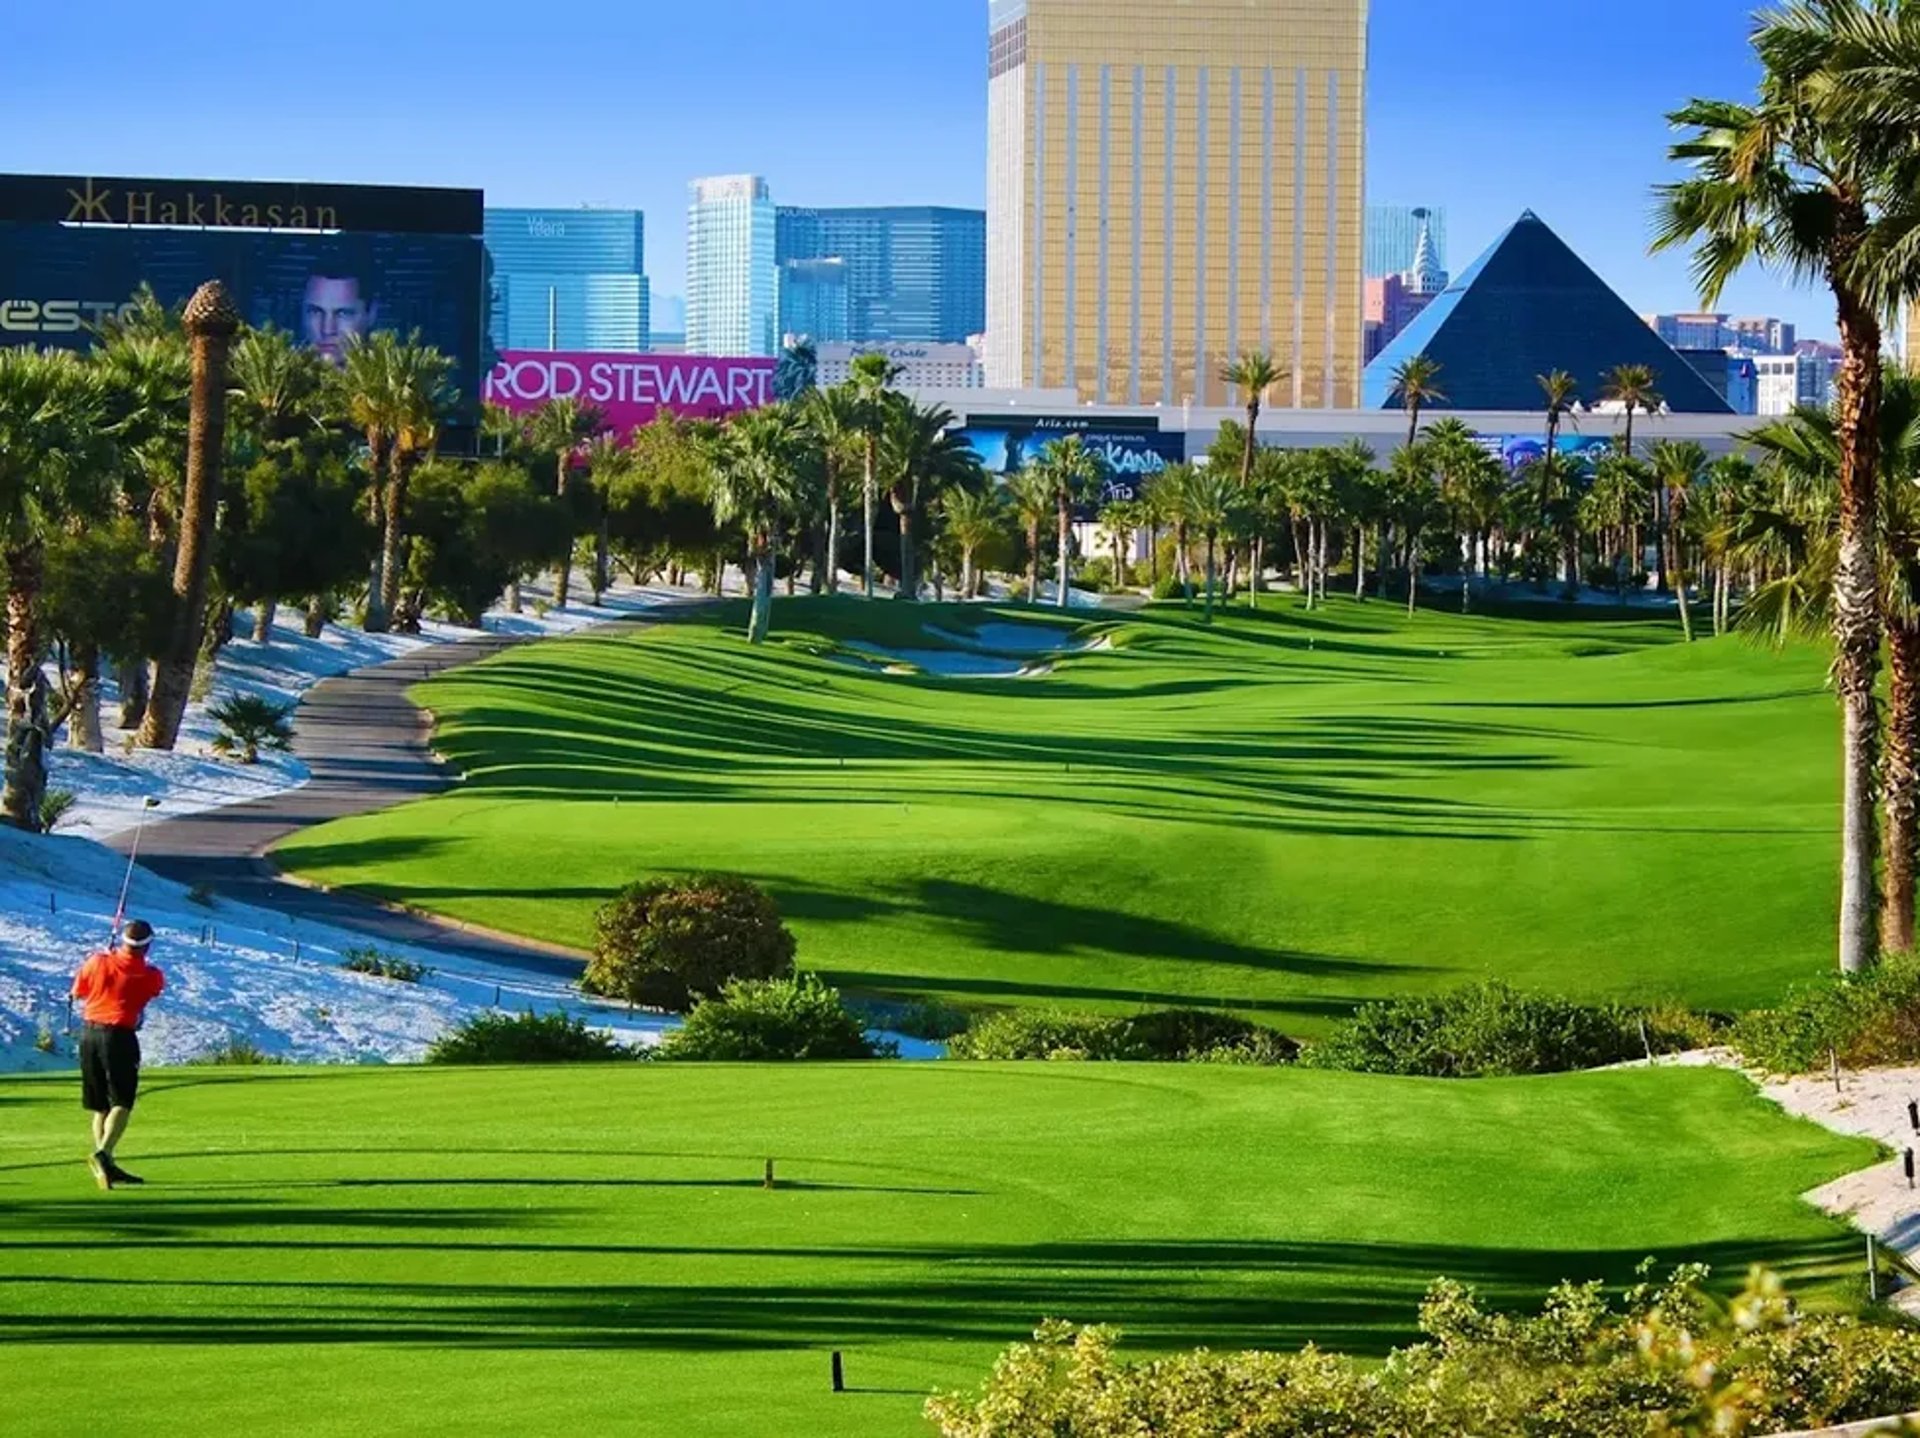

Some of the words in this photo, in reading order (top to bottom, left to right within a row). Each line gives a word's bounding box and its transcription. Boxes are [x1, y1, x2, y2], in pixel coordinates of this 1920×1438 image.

[126, 191, 337, 229] Hakkasan
[485, 360, 583, 400] ROD
[588, 362, 773, 406] STEWART
